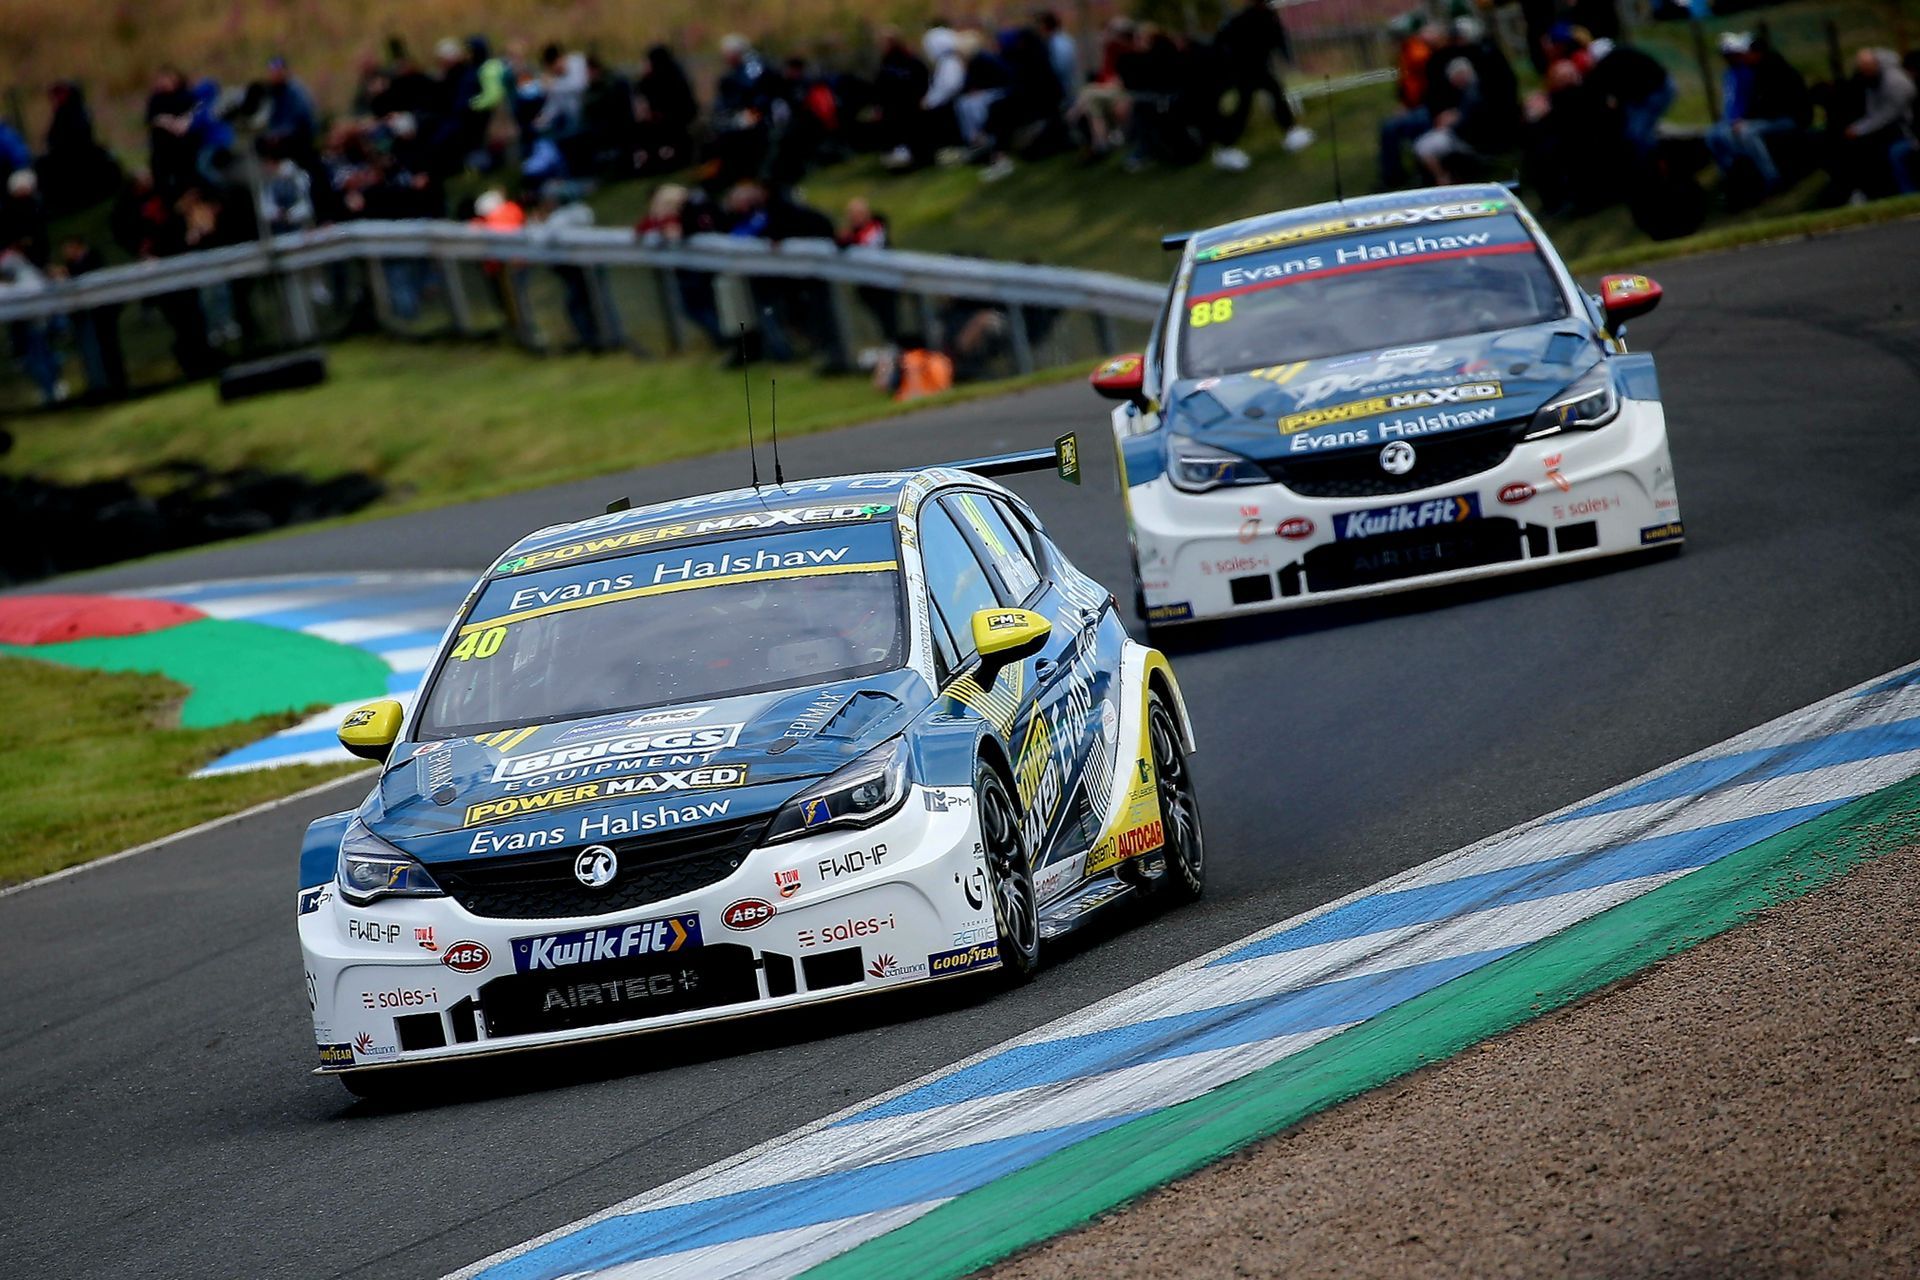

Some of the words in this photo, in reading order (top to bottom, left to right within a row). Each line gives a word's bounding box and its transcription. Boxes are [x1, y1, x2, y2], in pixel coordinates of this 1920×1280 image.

[1353, 202, 1487, 228] MAXED
[1222, 255, 1323, 288] Evans
[1335, 231, 1490, 265] Halshaw
[1190, 297, 1232, 328] 88
[1286, 398, 1387, 430] POWER
[1391, 385, 1497, 409] MAXED
[1290, 427, 1369, 452] Evans
[1378, 405, 1497, 440] Halshaw
[522, 525, 688, 568] POWER
[696, 505, 864, 533] MAXED
[508, 573, 633, 611] Evans
[652, 546, 849, 585] Halshaw
[450, 626, 507, 661] 40
[504, 750, 718, 792] EQUIPMENT
[509, 729, 727, 775] BRIGGS
[470, 784, 599, 823] POWER
[605, 767, 739, 796] MAXED
[469, 826, 566, 854] Evans
[579, 798, 731, 840] Halshaw
[1118, 820, 1164, 859] AUTOCAR
[781, 869, 799, 883] TOW
[414, 928, 428, 940] TOW
[731, 905, 770, 924] ABS
[822, 912, 897, 944] sales-i
[449, 948, 484, 965] ABS
[378, 986, 438, 1010] sales-i
[543, 973, 675, 1012] AIRTEC
